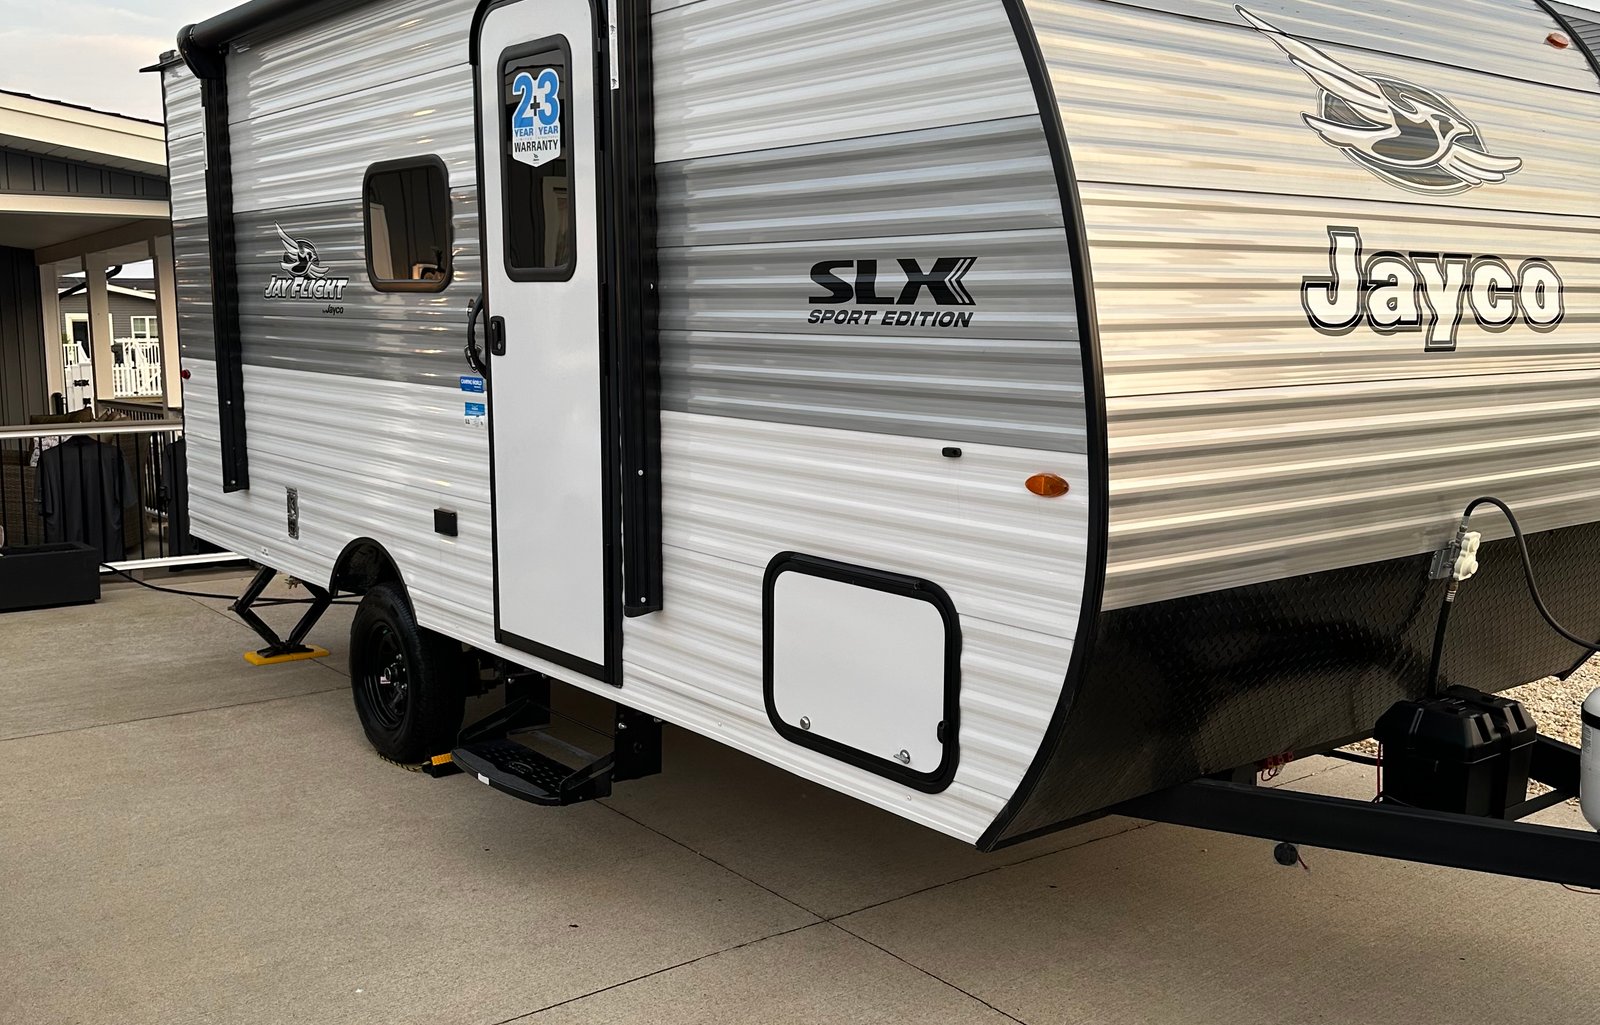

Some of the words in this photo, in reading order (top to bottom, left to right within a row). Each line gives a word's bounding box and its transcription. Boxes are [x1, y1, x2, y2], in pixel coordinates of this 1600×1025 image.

[514, 128, 534, 137] YEAR
[538, 125, 559, 135] YEAR
[514, 140, 559, 153] WARRANTY
[264, 274, 293, 299] JAY
[290, 276, 350, 300] FLIGHT
[808, 256, 978, 306] SLX
[1300, 225, 1565, 352] Jayco
[326, 304, 344, 315] Jayco
[807, 309, 878, 326] SPORT
[880, 311, 974, 328] EDITION
